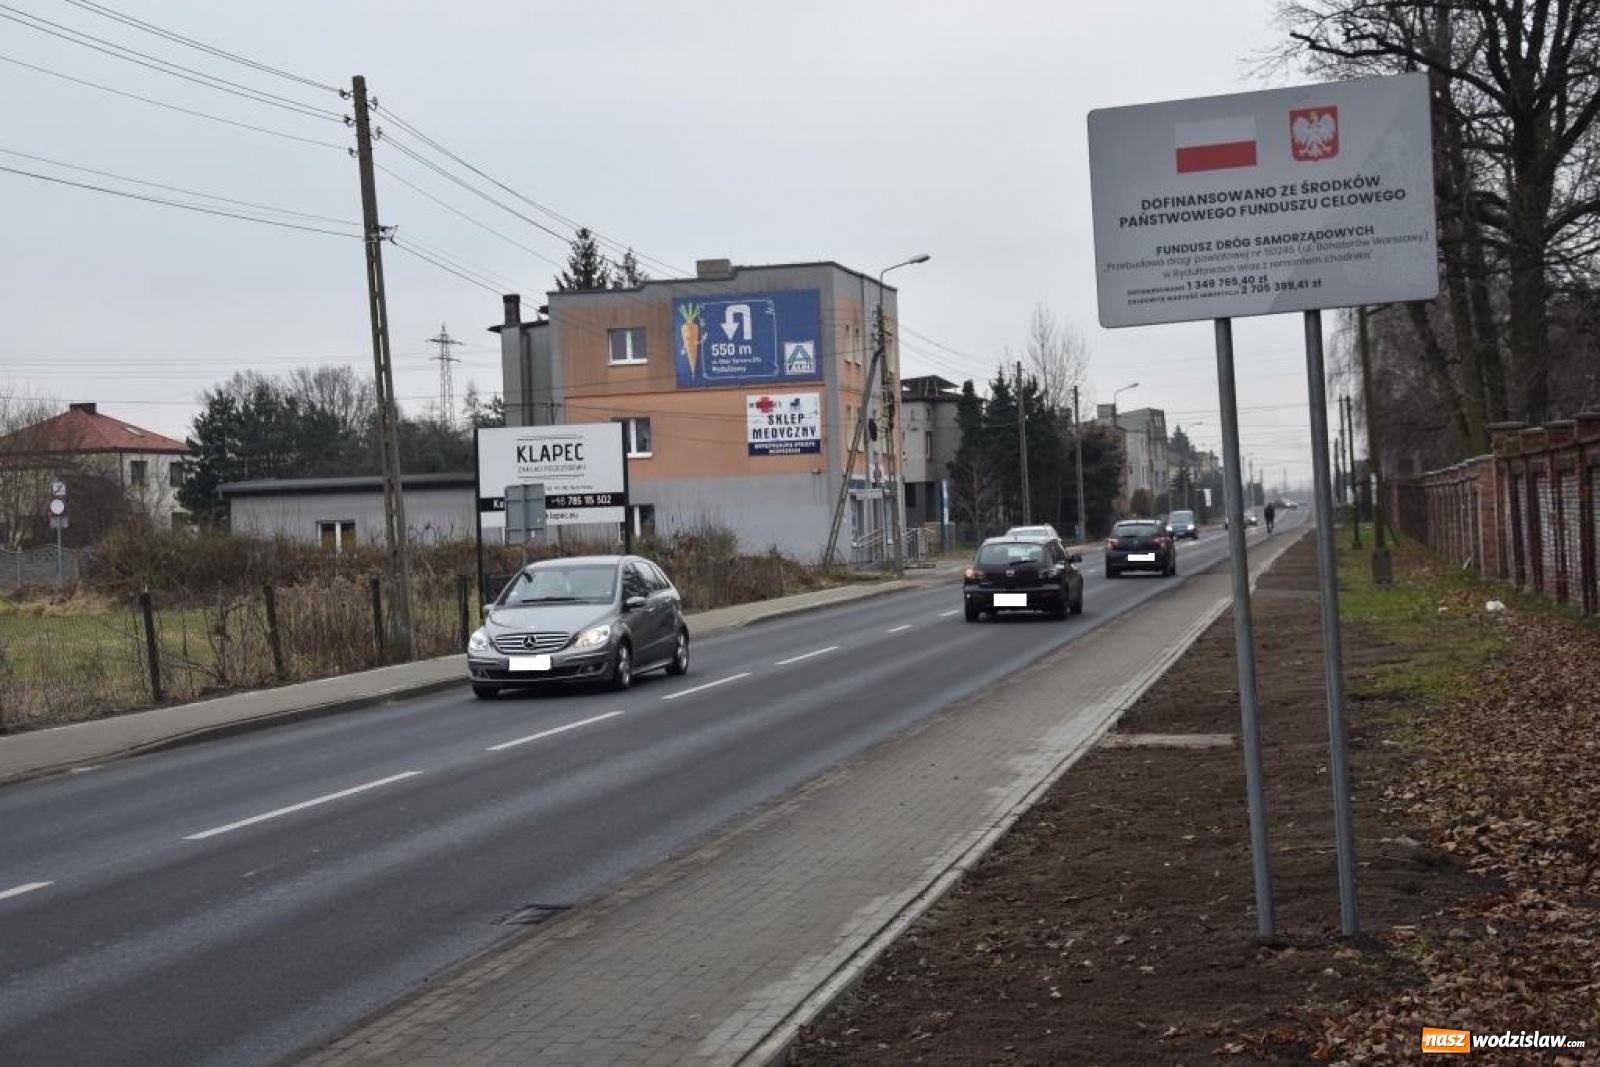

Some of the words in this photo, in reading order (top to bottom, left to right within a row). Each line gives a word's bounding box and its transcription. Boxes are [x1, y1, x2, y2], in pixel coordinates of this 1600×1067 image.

[1141, 186, 1277, 210] DOFINANSOWANO
[1281, 184, 1298, 197] ZE
[1301, 175, 1381, 194] ŚRODKÓW
[1119, 206, 1237, 228] PAŃSTWOWEGO
[1240, 199, 1318, 217] FUNDUSZU
[1321, 188, 1406, 208] CELOWEGO
[1155, 241, 1213, 256] FUNDUSZ
[1216, 236, 1251, 250] DRÓG
[1254, 225, 1374, 245] SAMORZĄDOWYCH
[1195, 279, 1215, 289] 349
[1218, 276, 1255, 287] 765,40
[1259, 274, 1268, 283] zł
[1241, 285, 1248, 295] 2
[1312, 277, 1322, 288] zł
[711, 343, 735, 357] 550
[739, 344, 753, 356] m
[768, 413, 805, 426] SKLEP
[752, 426, 816, 440] MEDYCZNY
[516, 443, 585, 463] KLAPEC
